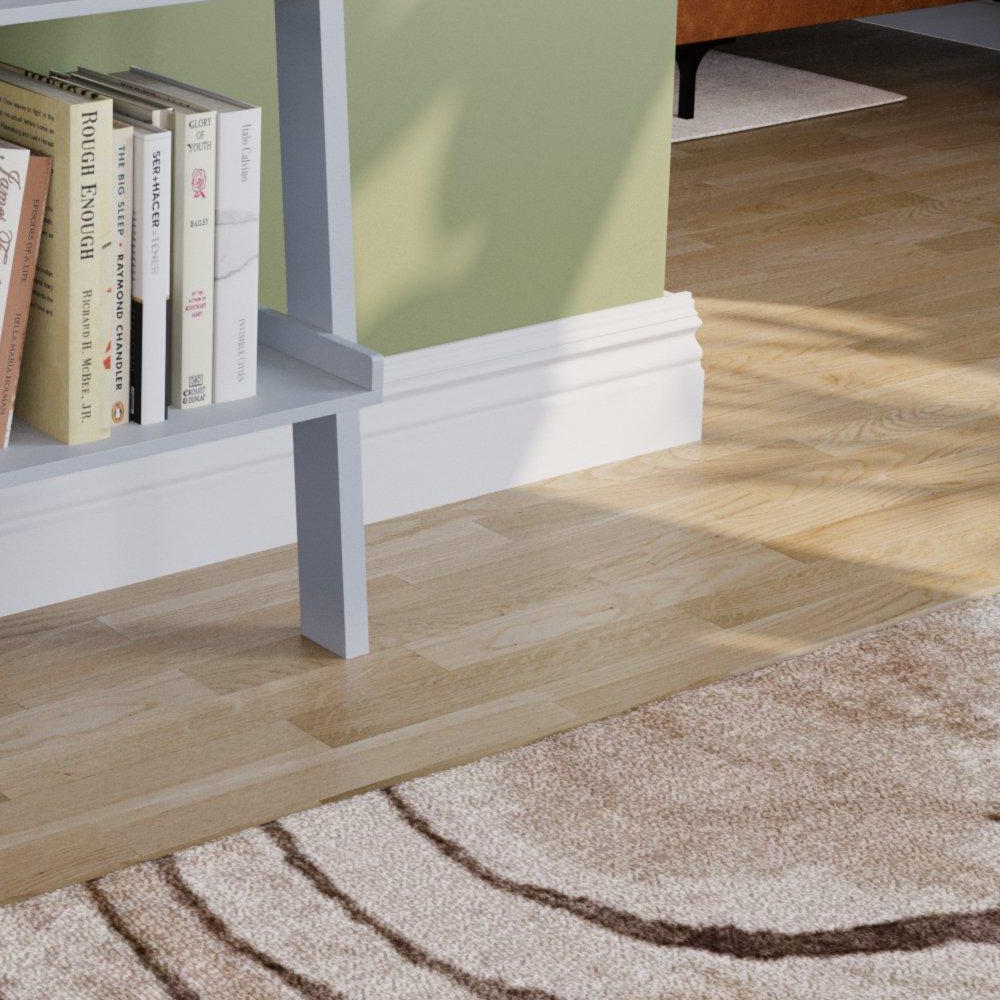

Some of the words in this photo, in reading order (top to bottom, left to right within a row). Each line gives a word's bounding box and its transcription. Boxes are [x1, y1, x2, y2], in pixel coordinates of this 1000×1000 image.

[189, 117, 211, 129] GLORY
[196, 131, 204, 140] OF
[241, 123, 252, 146] Italo
[81, 110, 98, 176] ROUGH
[117, 145, 126, 168] THE
[187, 141, 211, 152] YOUTH
[241, 148, 252, 183] Calvino
[117, 174, 125, 196] BIG
[26, 199, 39, 241] EPISODES
[80, 183, 97, 261] ENOUGH
[116, 202, 125, 236] SLEEP
[115, 254, 124, 319] RAYMOND
[115, 324, 124, 391] CHANDLER
